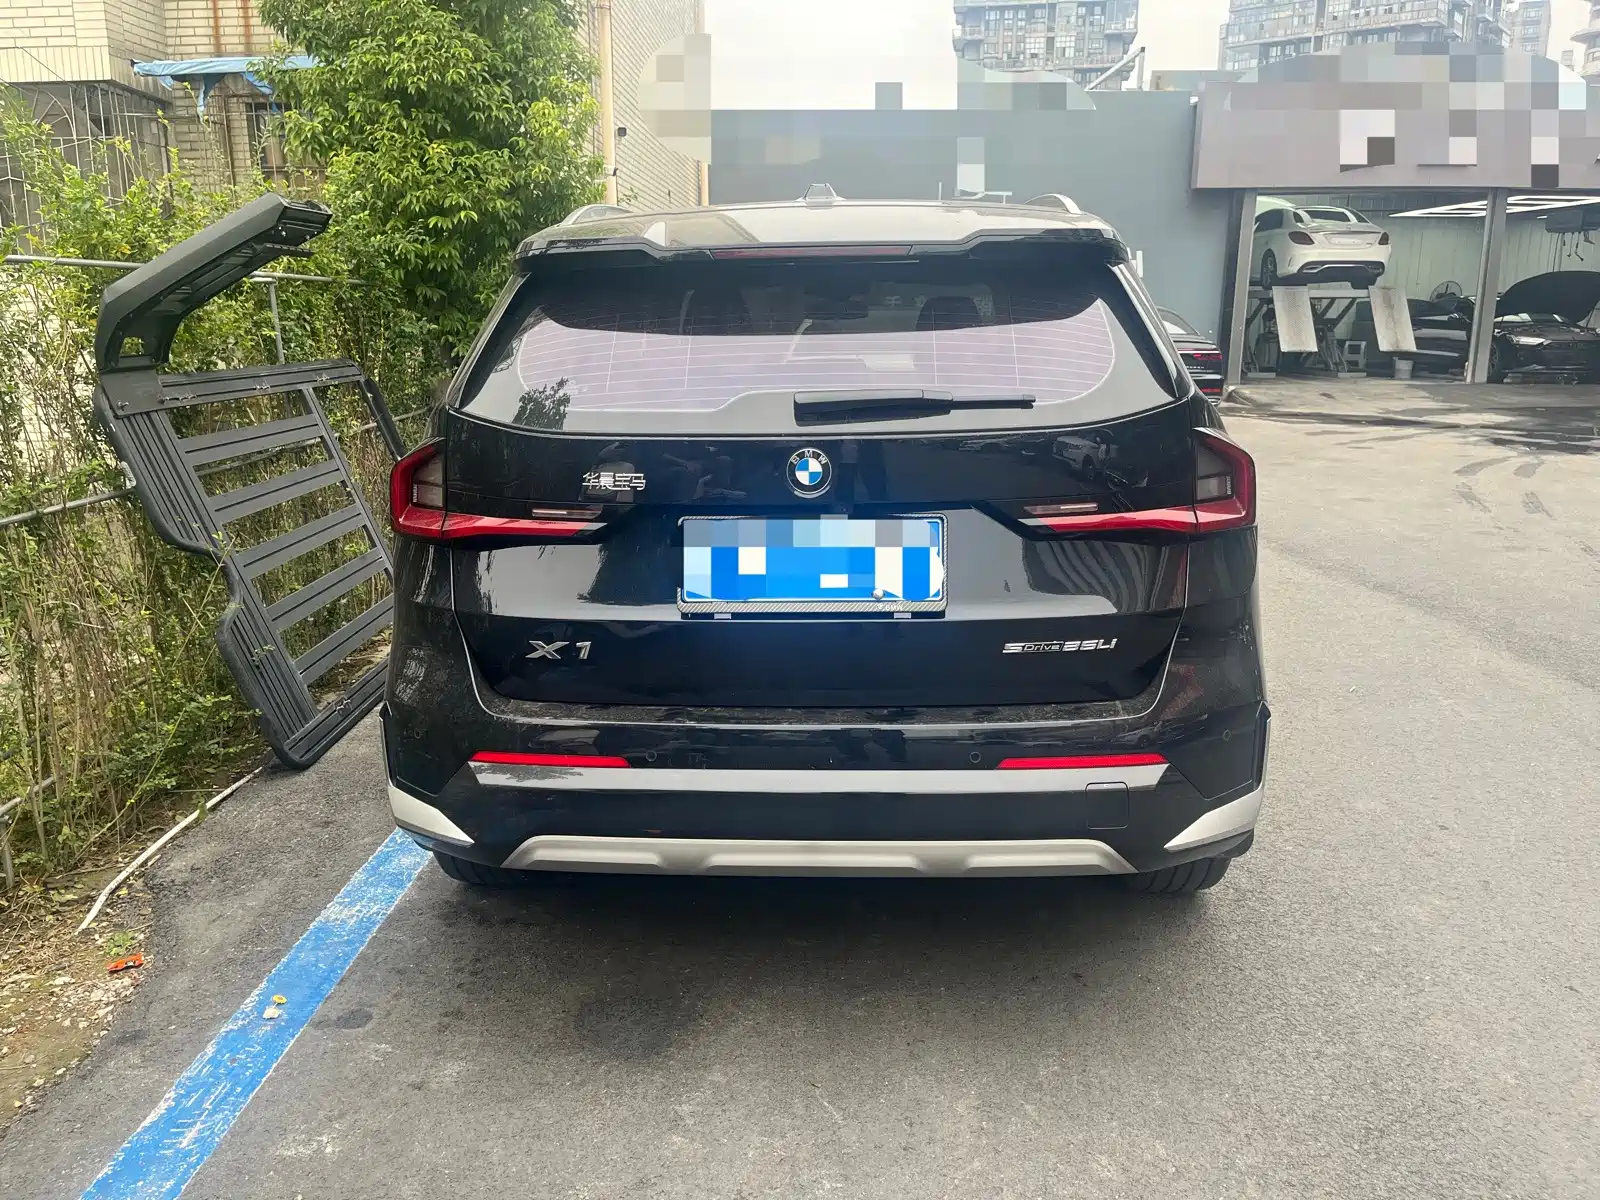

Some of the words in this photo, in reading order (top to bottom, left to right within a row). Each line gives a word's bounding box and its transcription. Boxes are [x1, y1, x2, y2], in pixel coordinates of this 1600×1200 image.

[790, 450, 829, 465] BMW
[582, 472, 646, 490] 华晨宝马
[525, 640, 592, 660] X1
